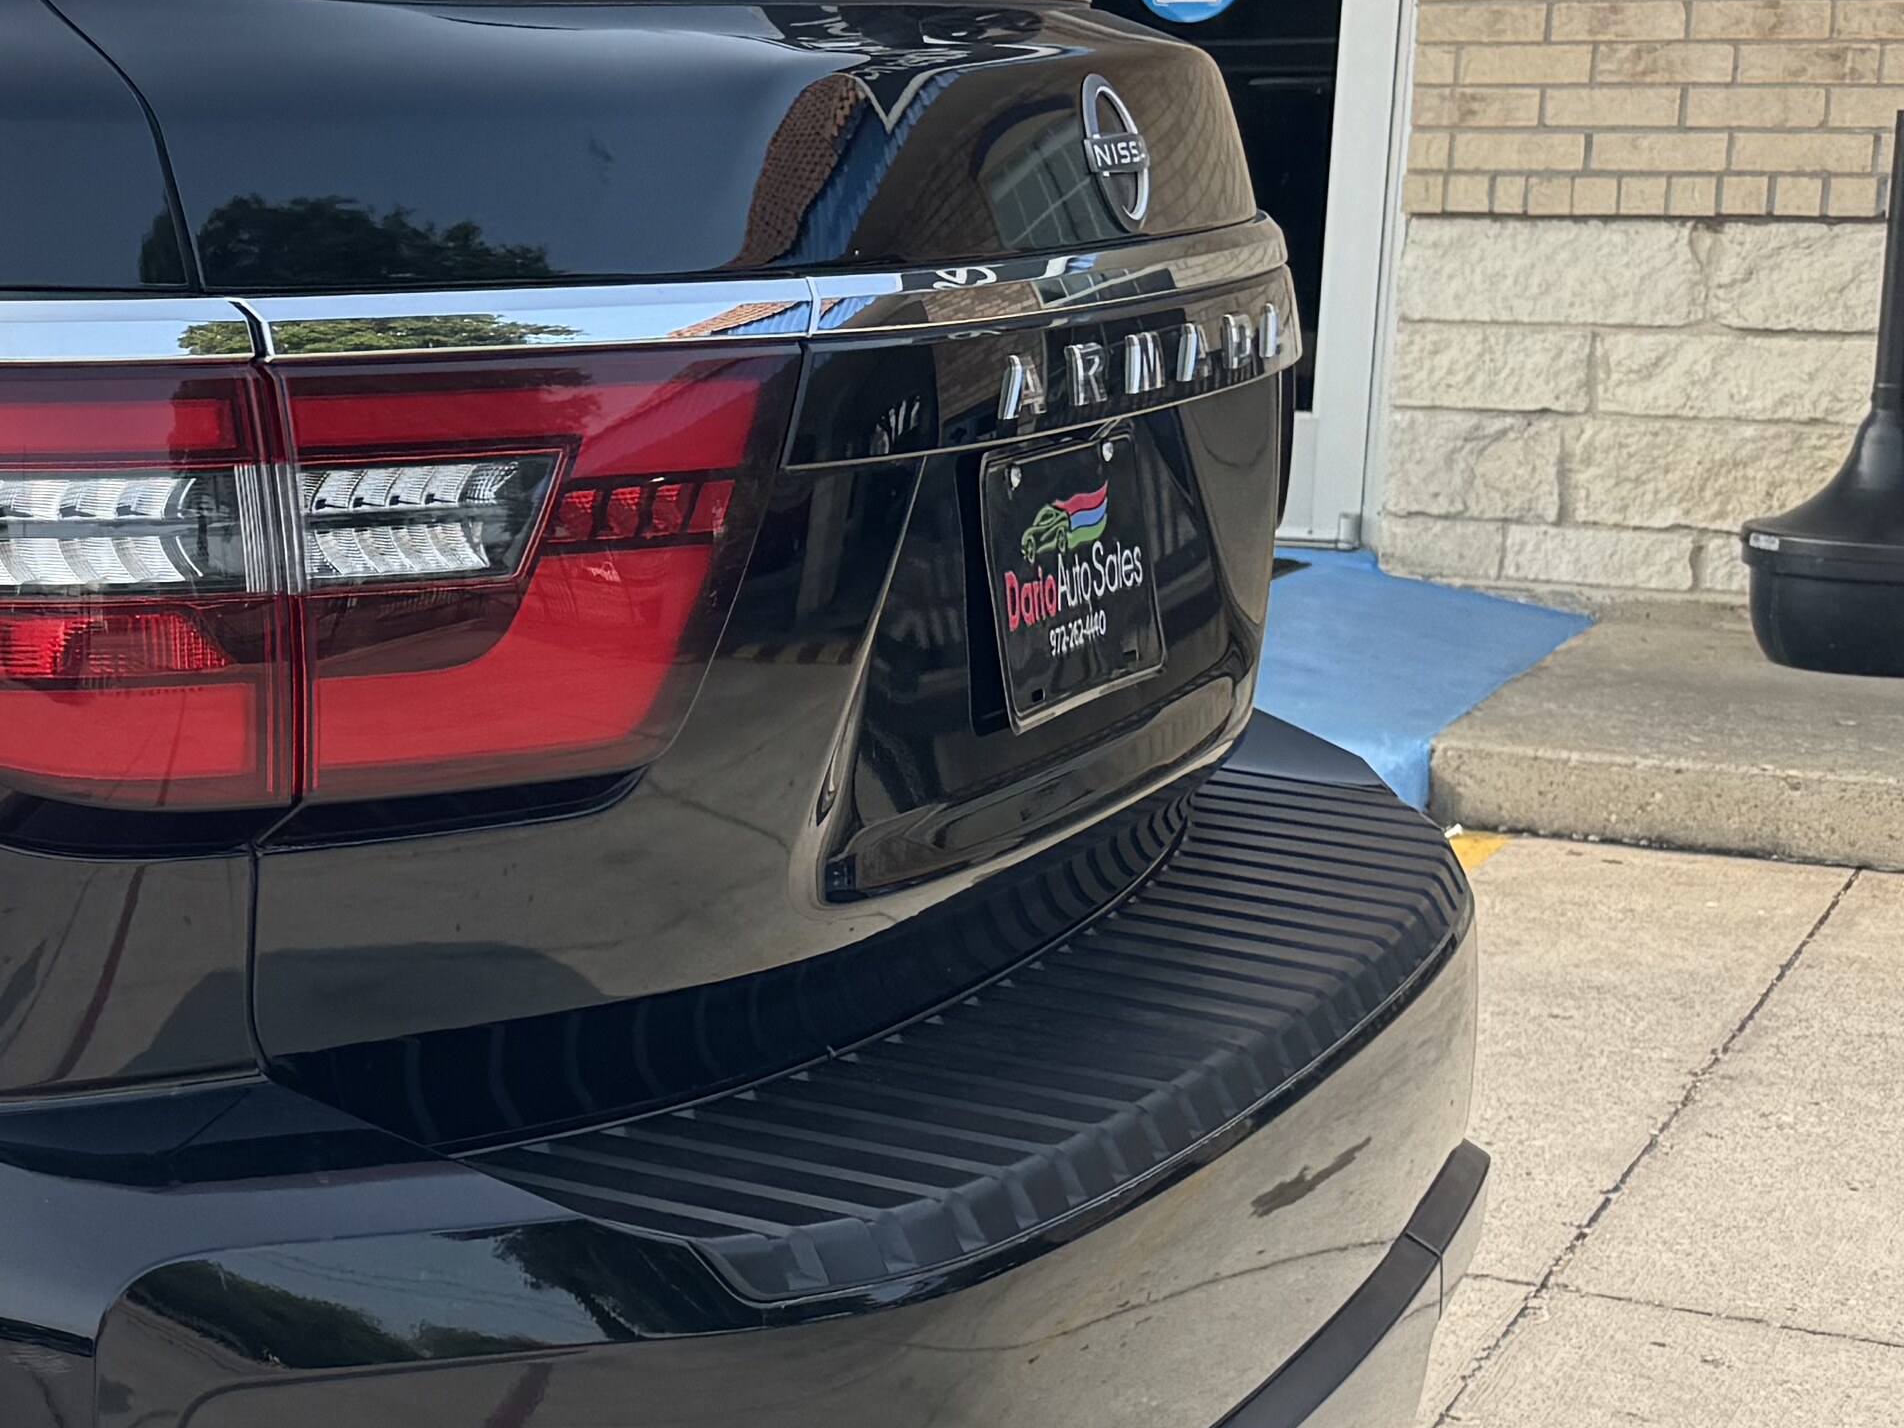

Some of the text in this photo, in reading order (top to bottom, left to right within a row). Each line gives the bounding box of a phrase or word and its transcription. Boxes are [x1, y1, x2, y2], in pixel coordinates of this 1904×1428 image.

[1093, 140, 1148, 169] NISS
[1004, 566, 1057, 632] Dario
[1091, 540, 1144, 598] Sales
